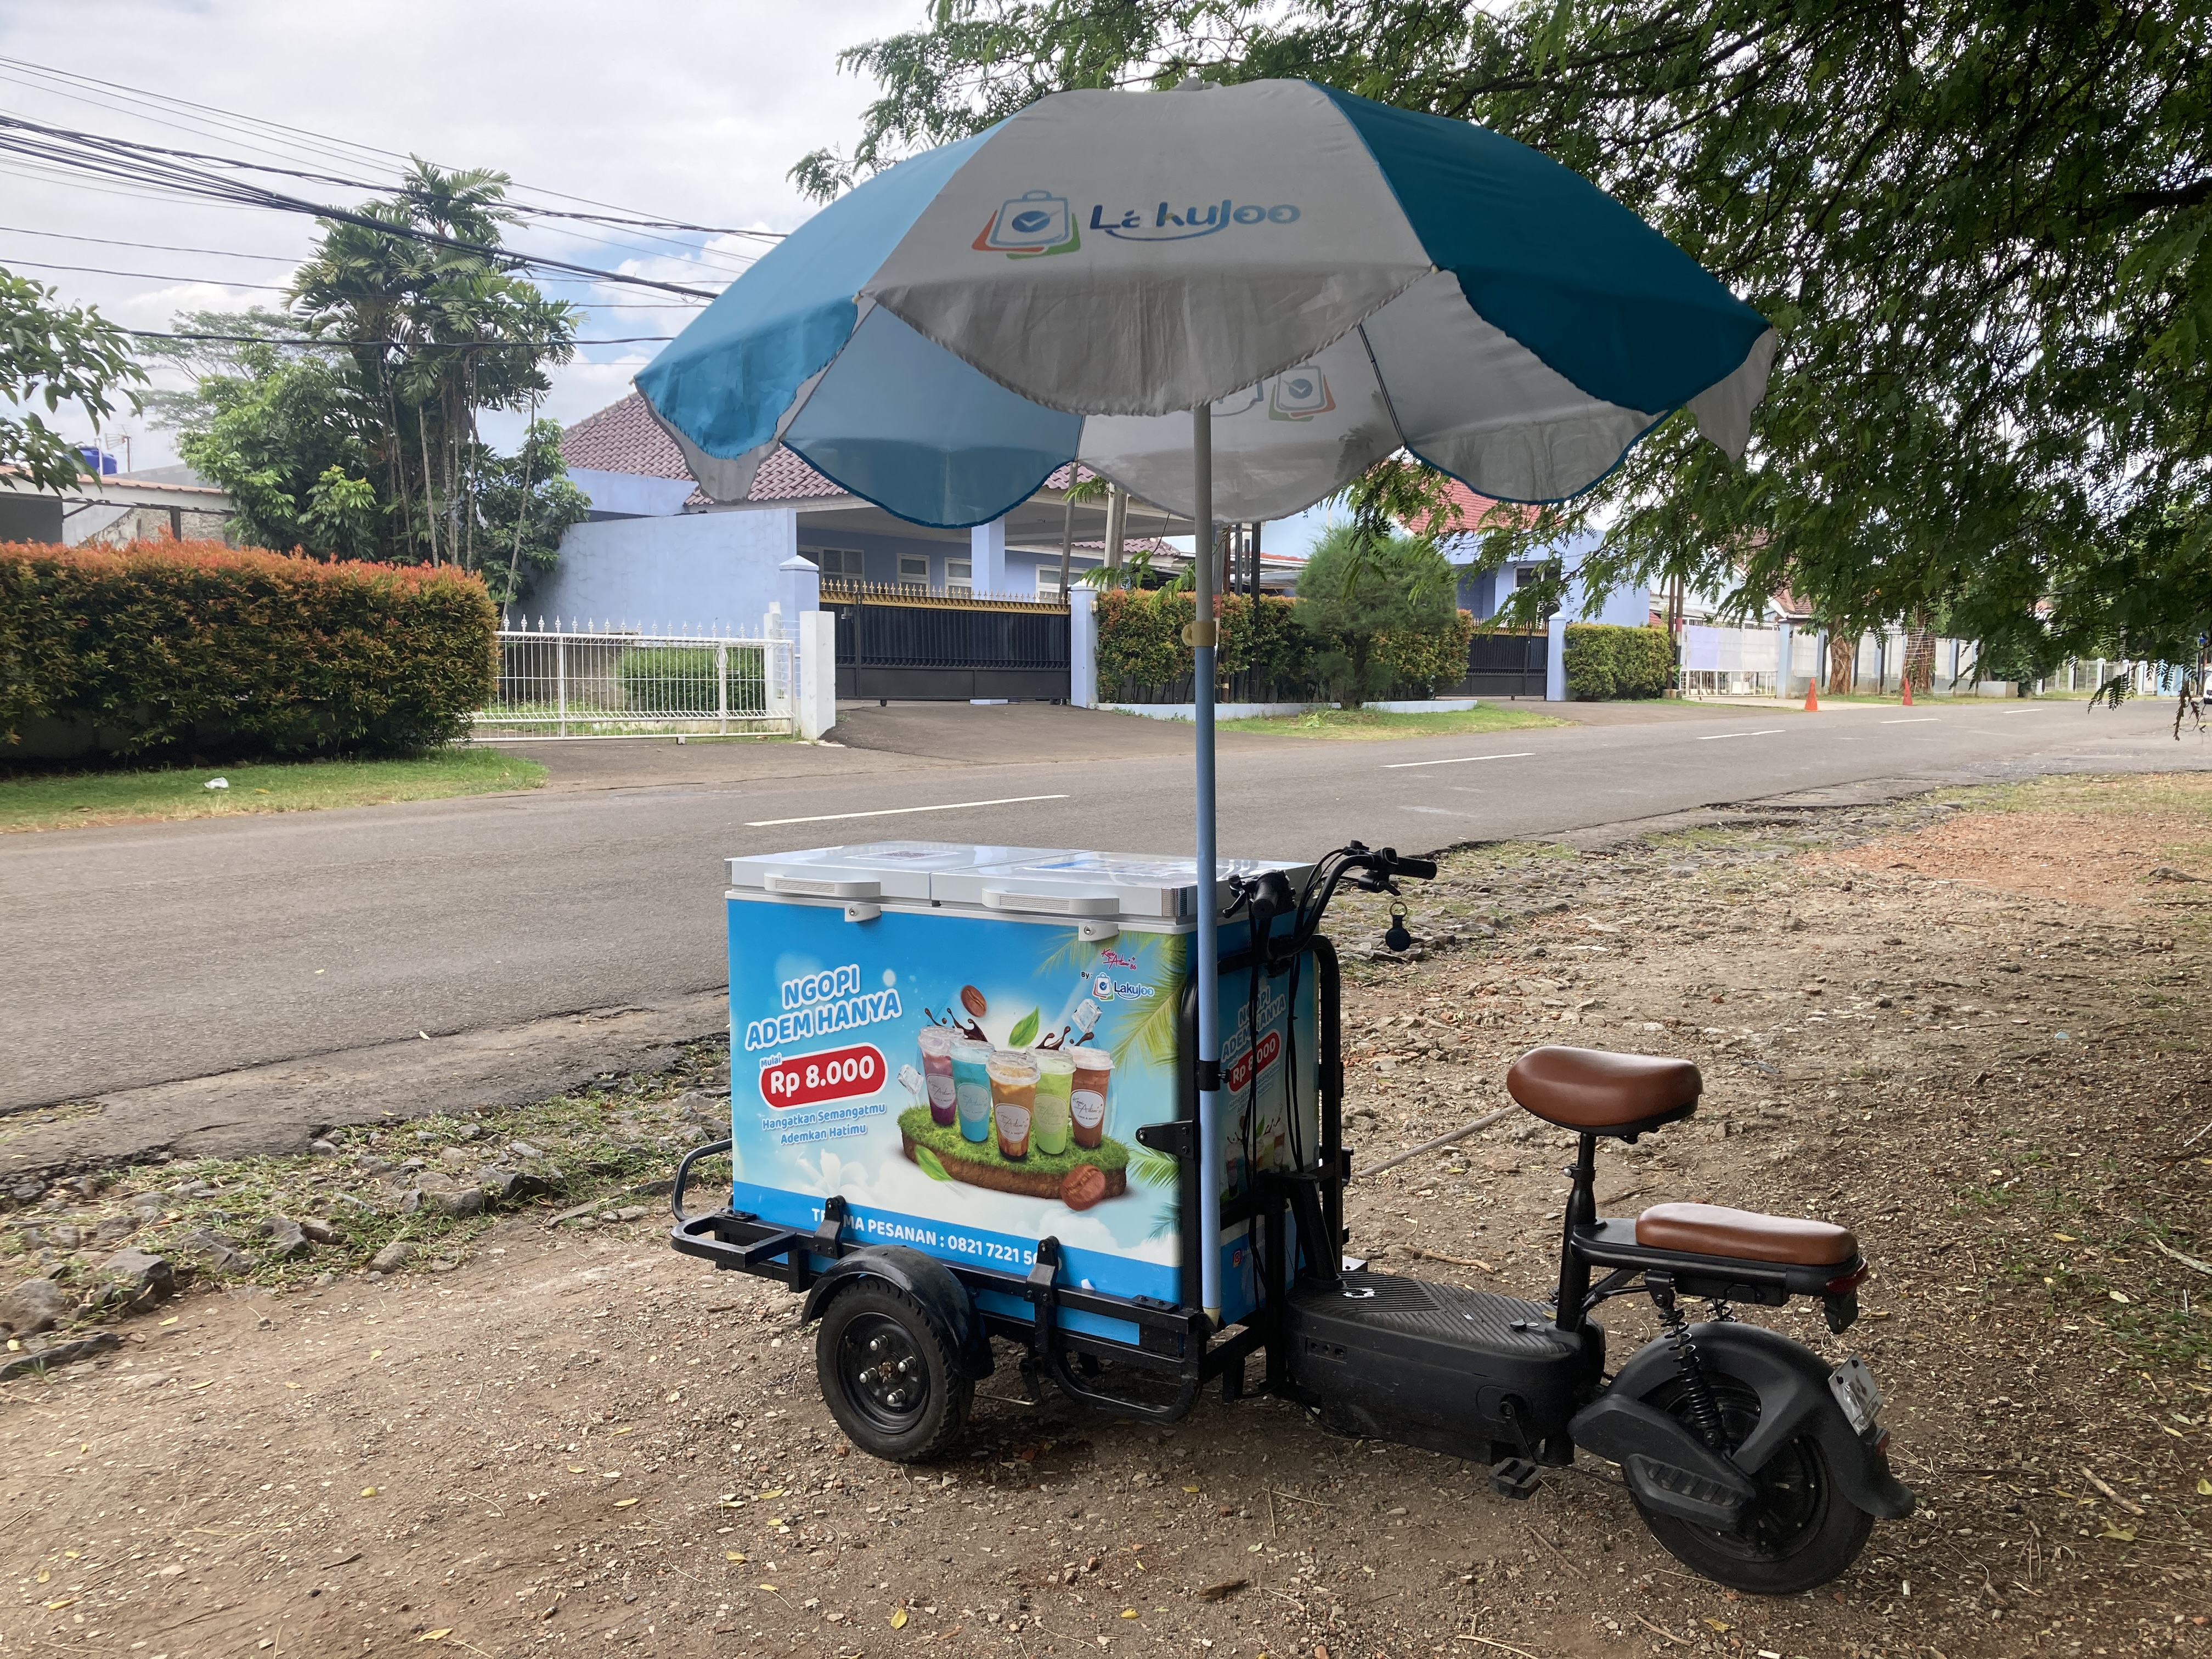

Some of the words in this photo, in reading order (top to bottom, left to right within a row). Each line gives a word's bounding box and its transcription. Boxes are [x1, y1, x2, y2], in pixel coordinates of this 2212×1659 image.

[783, 967, 858, 1007] NGOPI
[747, 1012, 812, 1048] ADEM
[817, 991, 901, 1032] HANYA
[761, 1054, 781, 1068] Mulai
[1248, 1037, 1276, 1071] 8000
[770, 1070, 800, 1098] Rp
[805, 1055, 875, 1088] 8.000
[762, 1114, 815, 1130] Hangatkan
[817, 1104, 885, 1121] Semangatmu
[780, 1130, 827, 1144] Ademkan
[829, 1124, 866, 1138] Hatimu
[867, 1218, 936, 1246] PESANAN
[947, 1234, 983, 1256] 0821
[985, 1243, 1019, 1263] 7221
